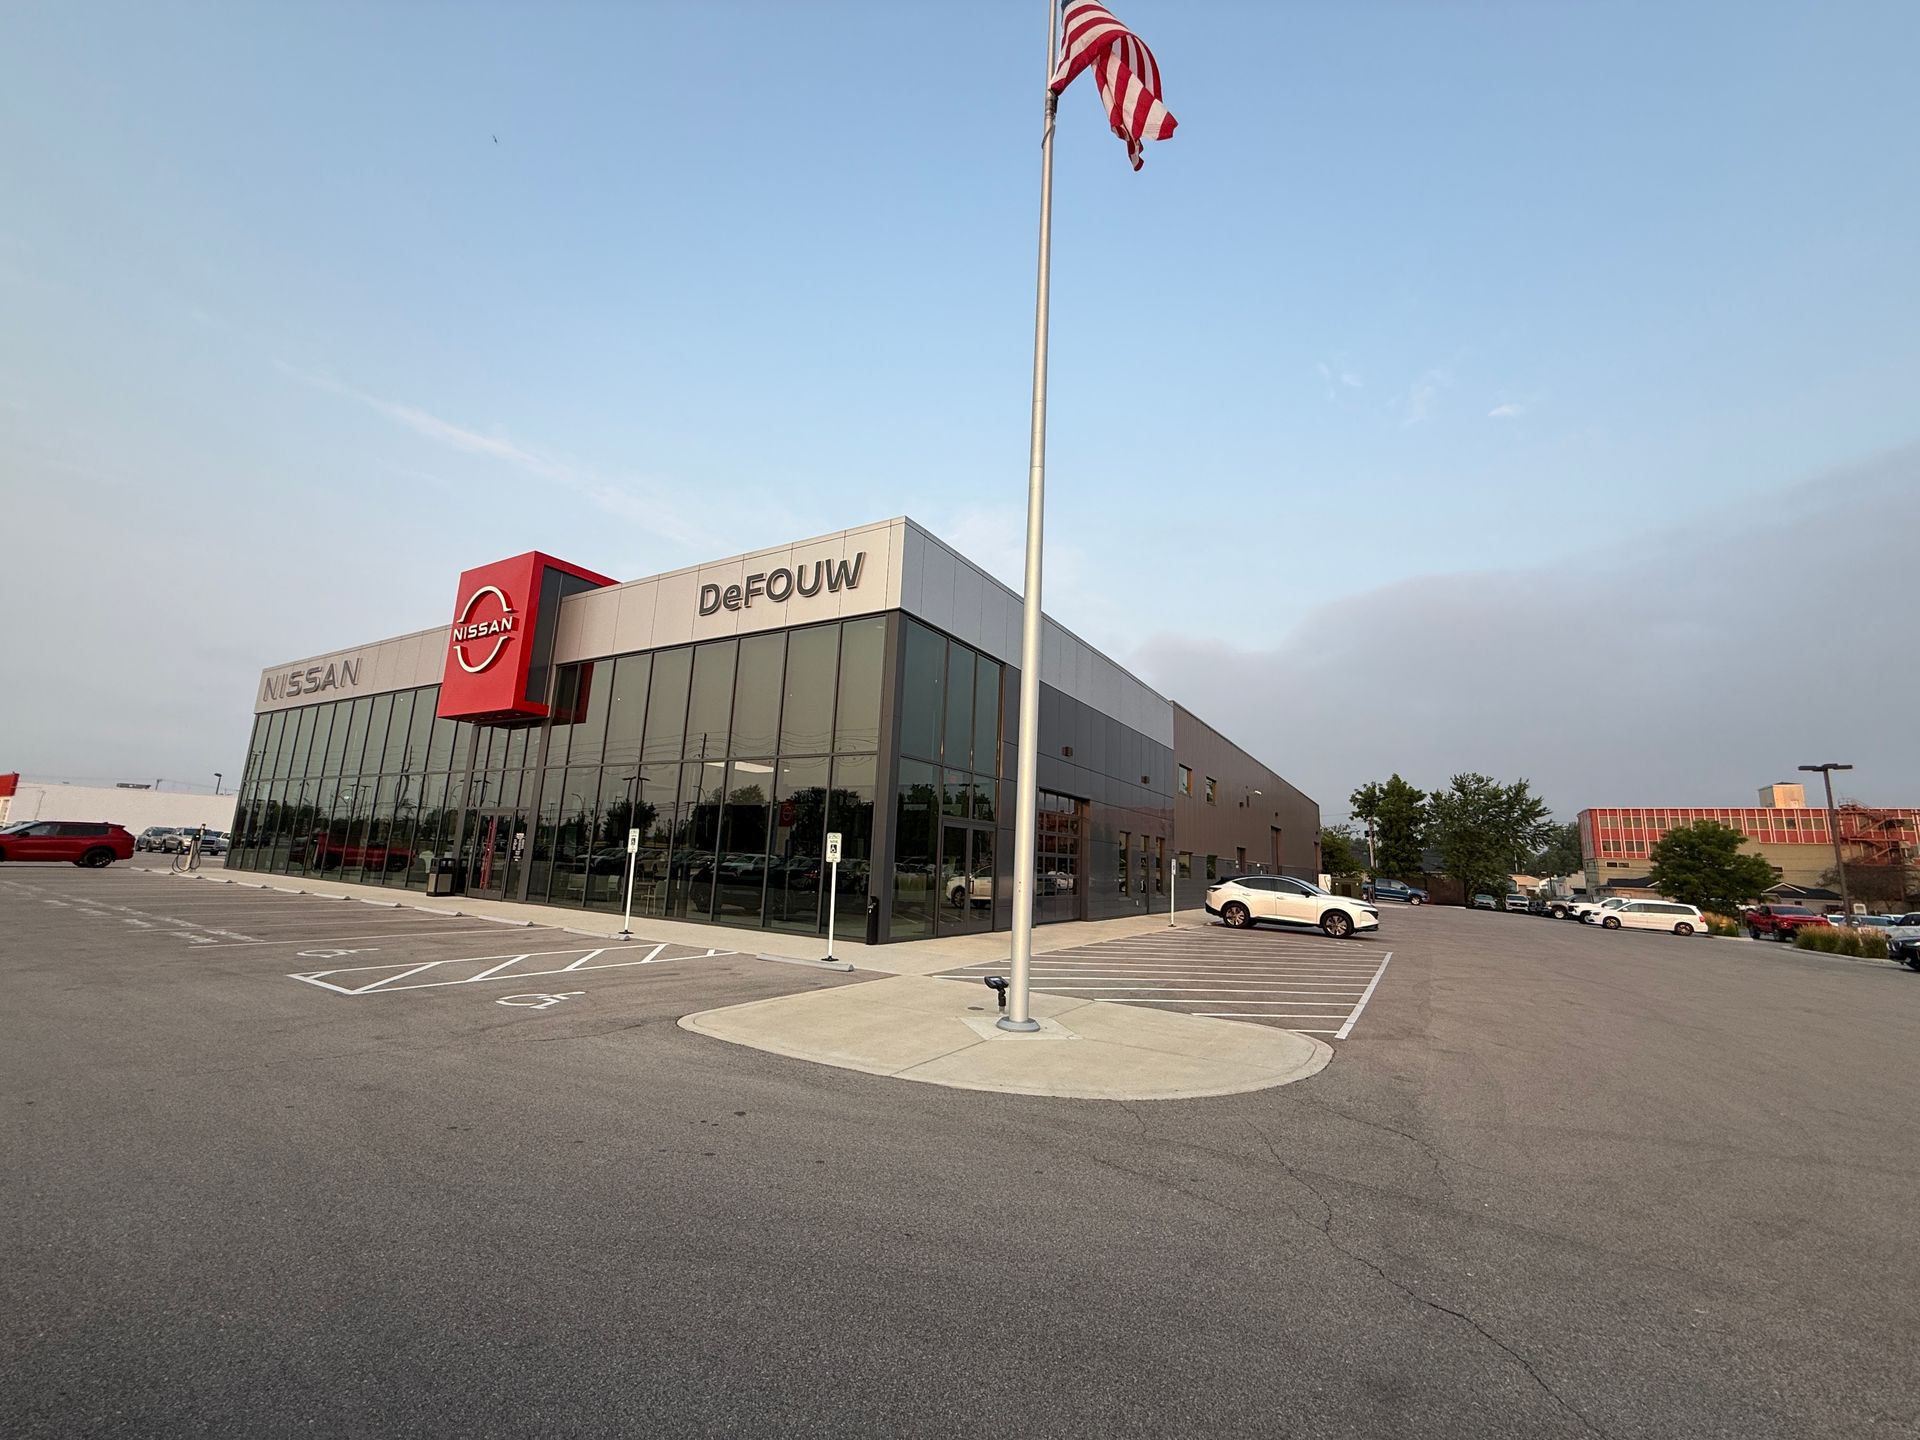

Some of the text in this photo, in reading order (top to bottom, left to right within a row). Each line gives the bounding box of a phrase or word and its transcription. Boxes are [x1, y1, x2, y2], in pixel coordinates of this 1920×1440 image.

[699, 551, 866, 616] DeFOUW
[453, 616, 513, 641] NISSAN
[263, 658, 361, 702] NISSAN
